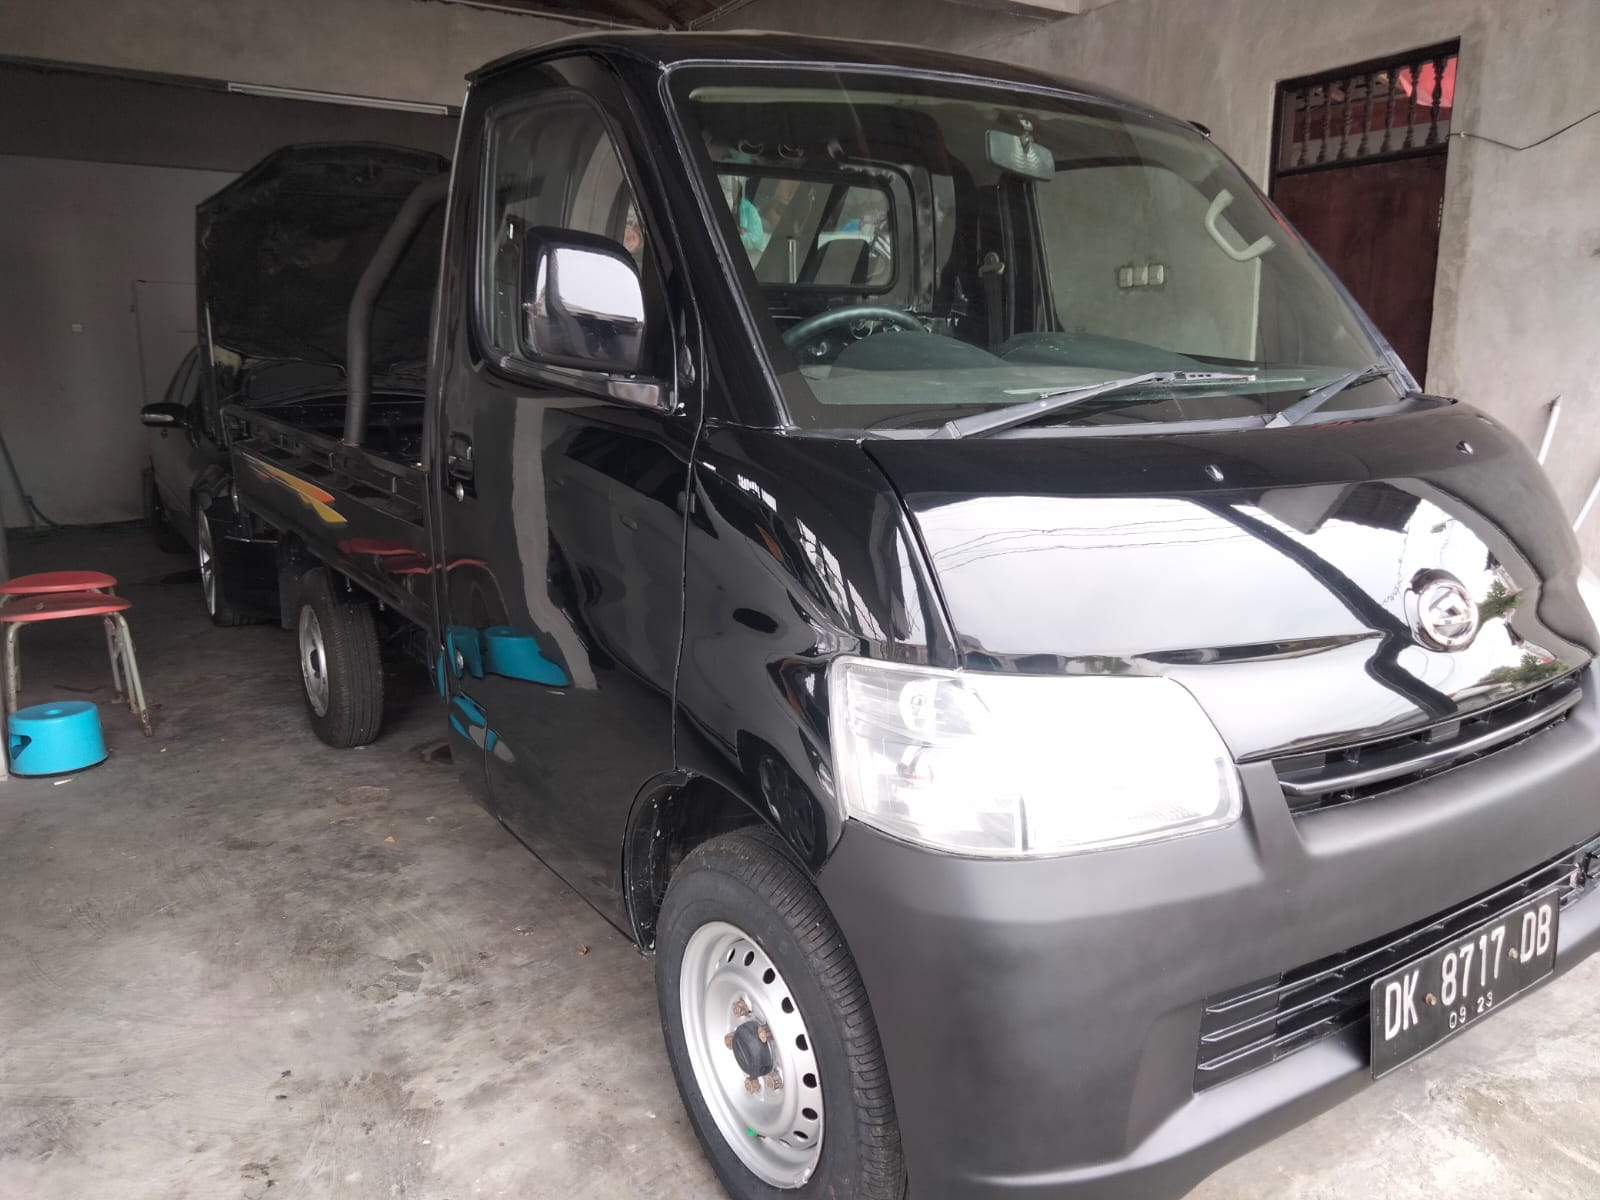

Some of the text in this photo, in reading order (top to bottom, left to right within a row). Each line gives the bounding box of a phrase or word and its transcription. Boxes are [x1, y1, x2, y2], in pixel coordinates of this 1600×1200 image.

[1385, 904, 1552, 1041] DK 8717 DB
[1449, 991, 1493, 1029] 09 23
